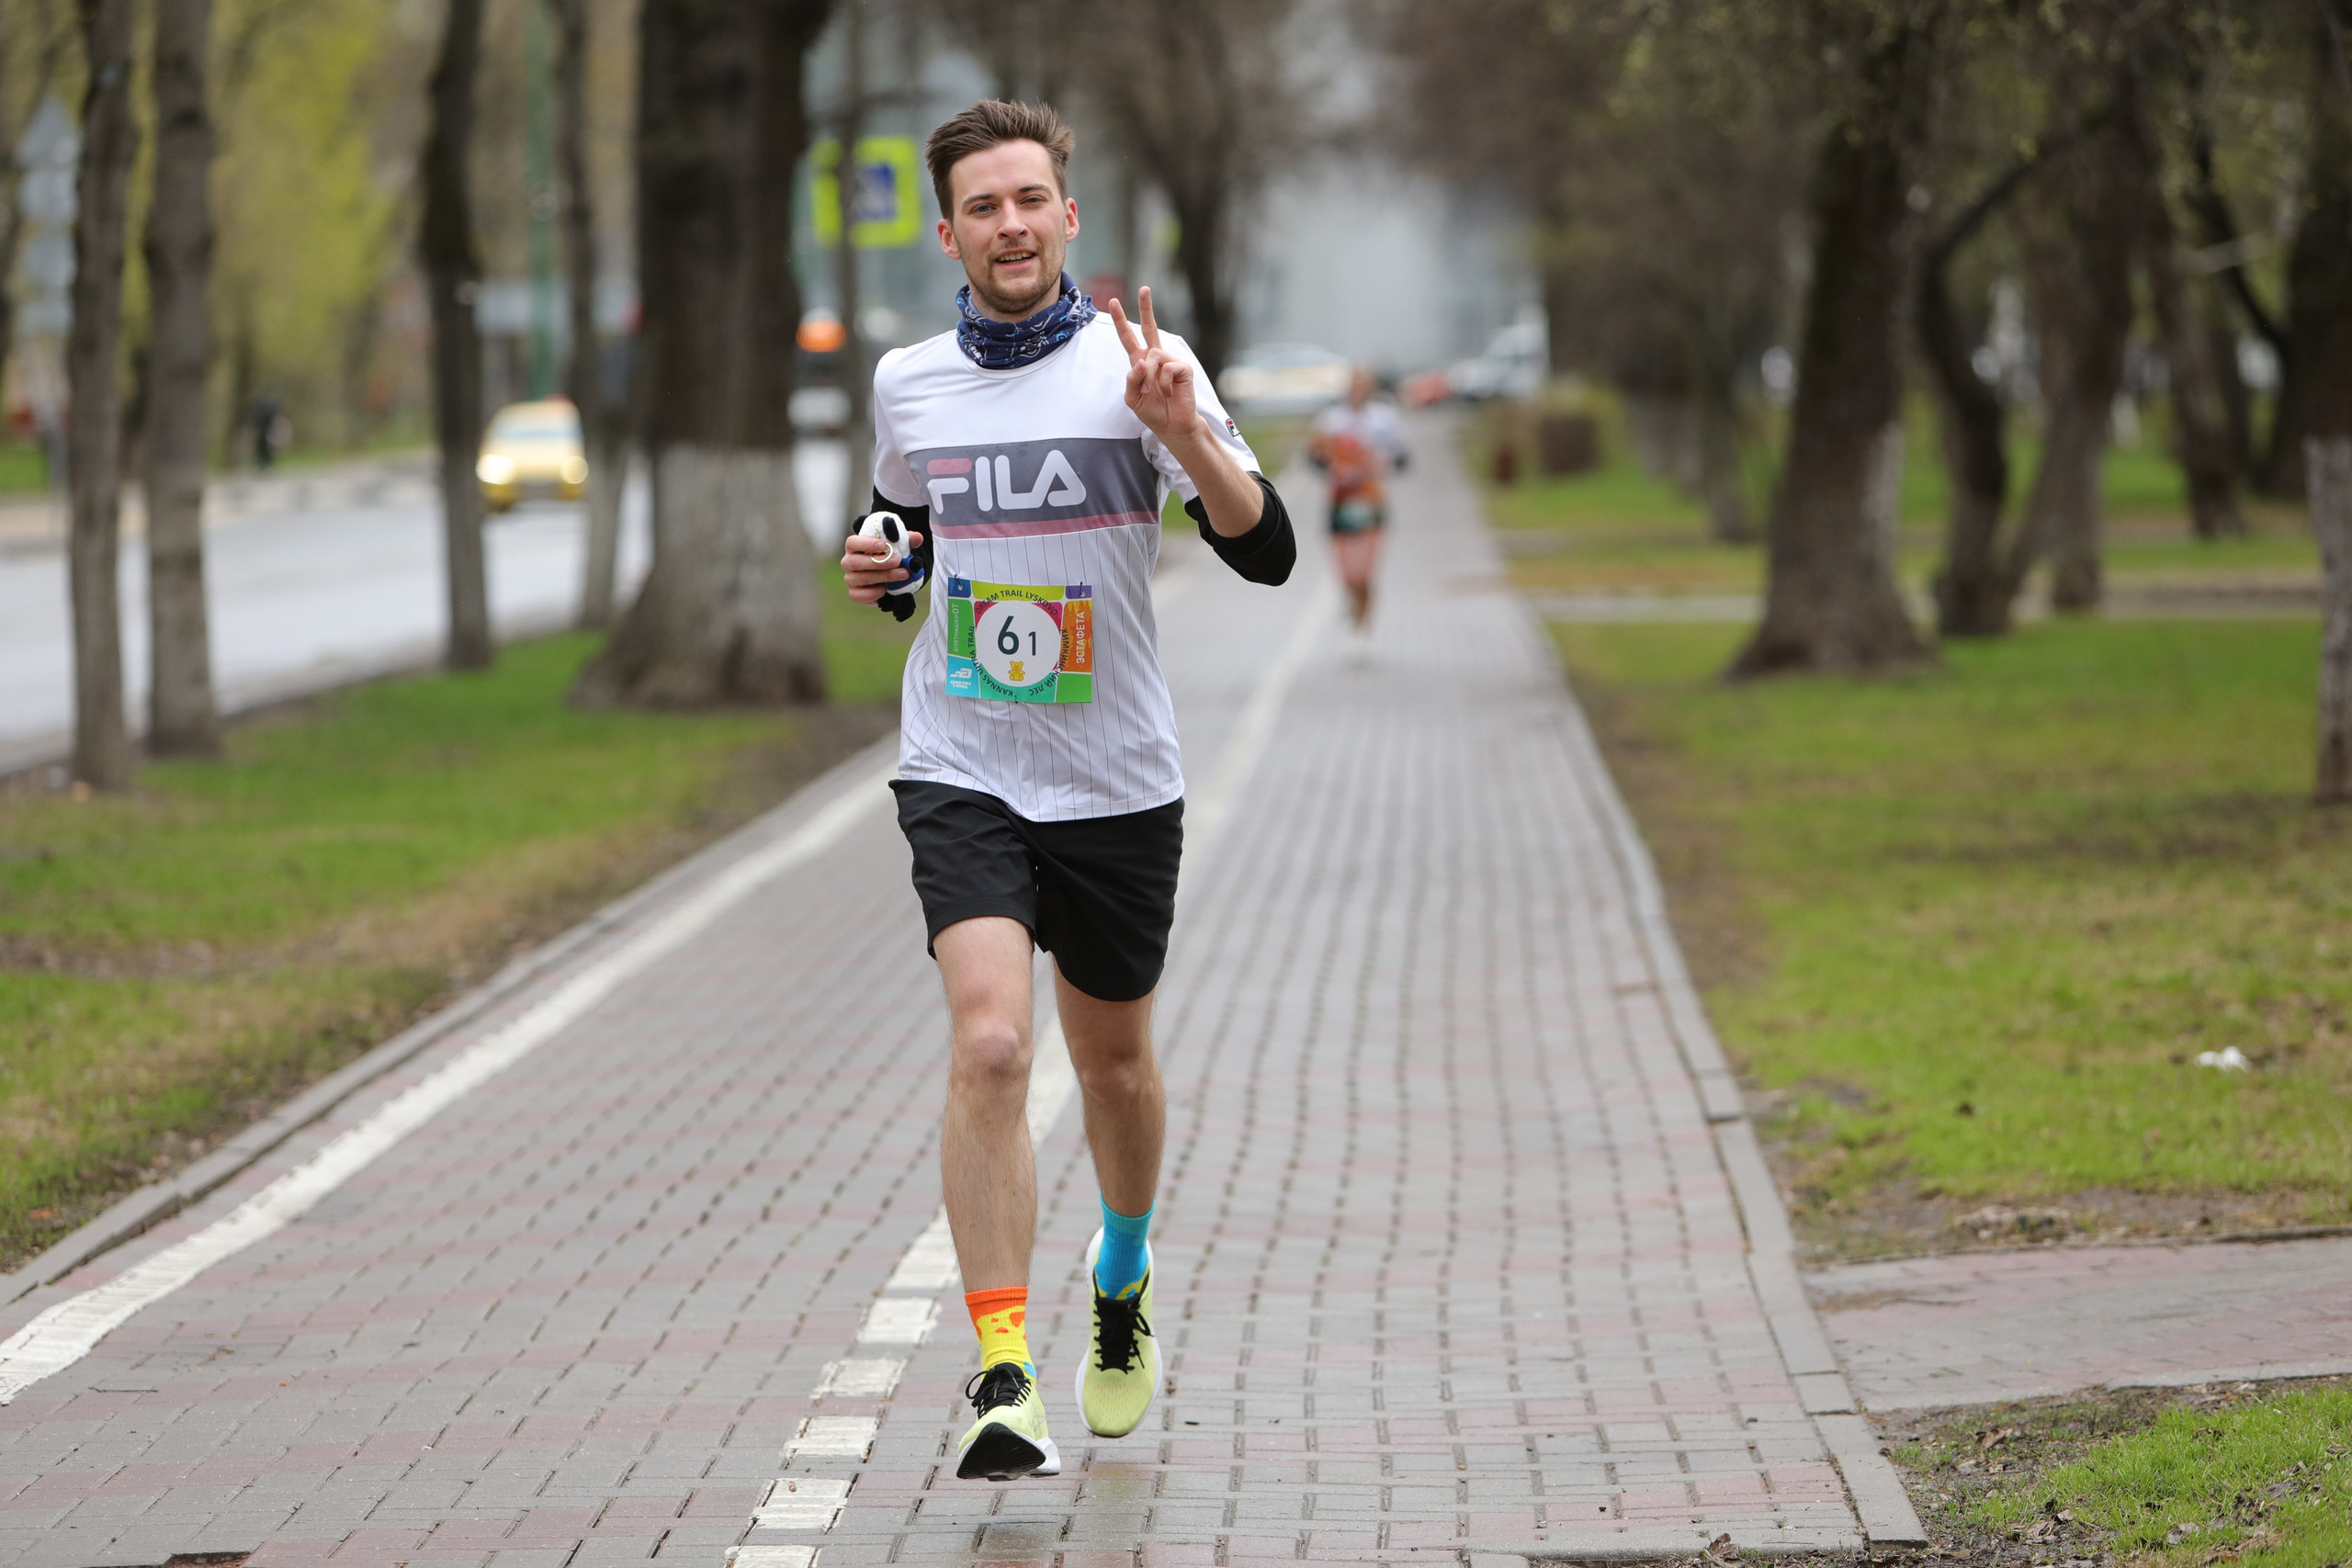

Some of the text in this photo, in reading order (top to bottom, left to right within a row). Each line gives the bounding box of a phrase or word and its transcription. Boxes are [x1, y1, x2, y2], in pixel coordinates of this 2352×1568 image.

[926, 449, 1087, 514] FILA
[975, 589, 1058, 615] DREAM TRAIL LYSKOVO
[967, 626, 976, 649] TRAIL
[1076, 611, 1085, 664] ЭСТАФЕТА
[1028, 628, 1069, 696] ХИМКИНСКИЙ ЛЕС
[982, 674, 1013, 696] KANNAS
